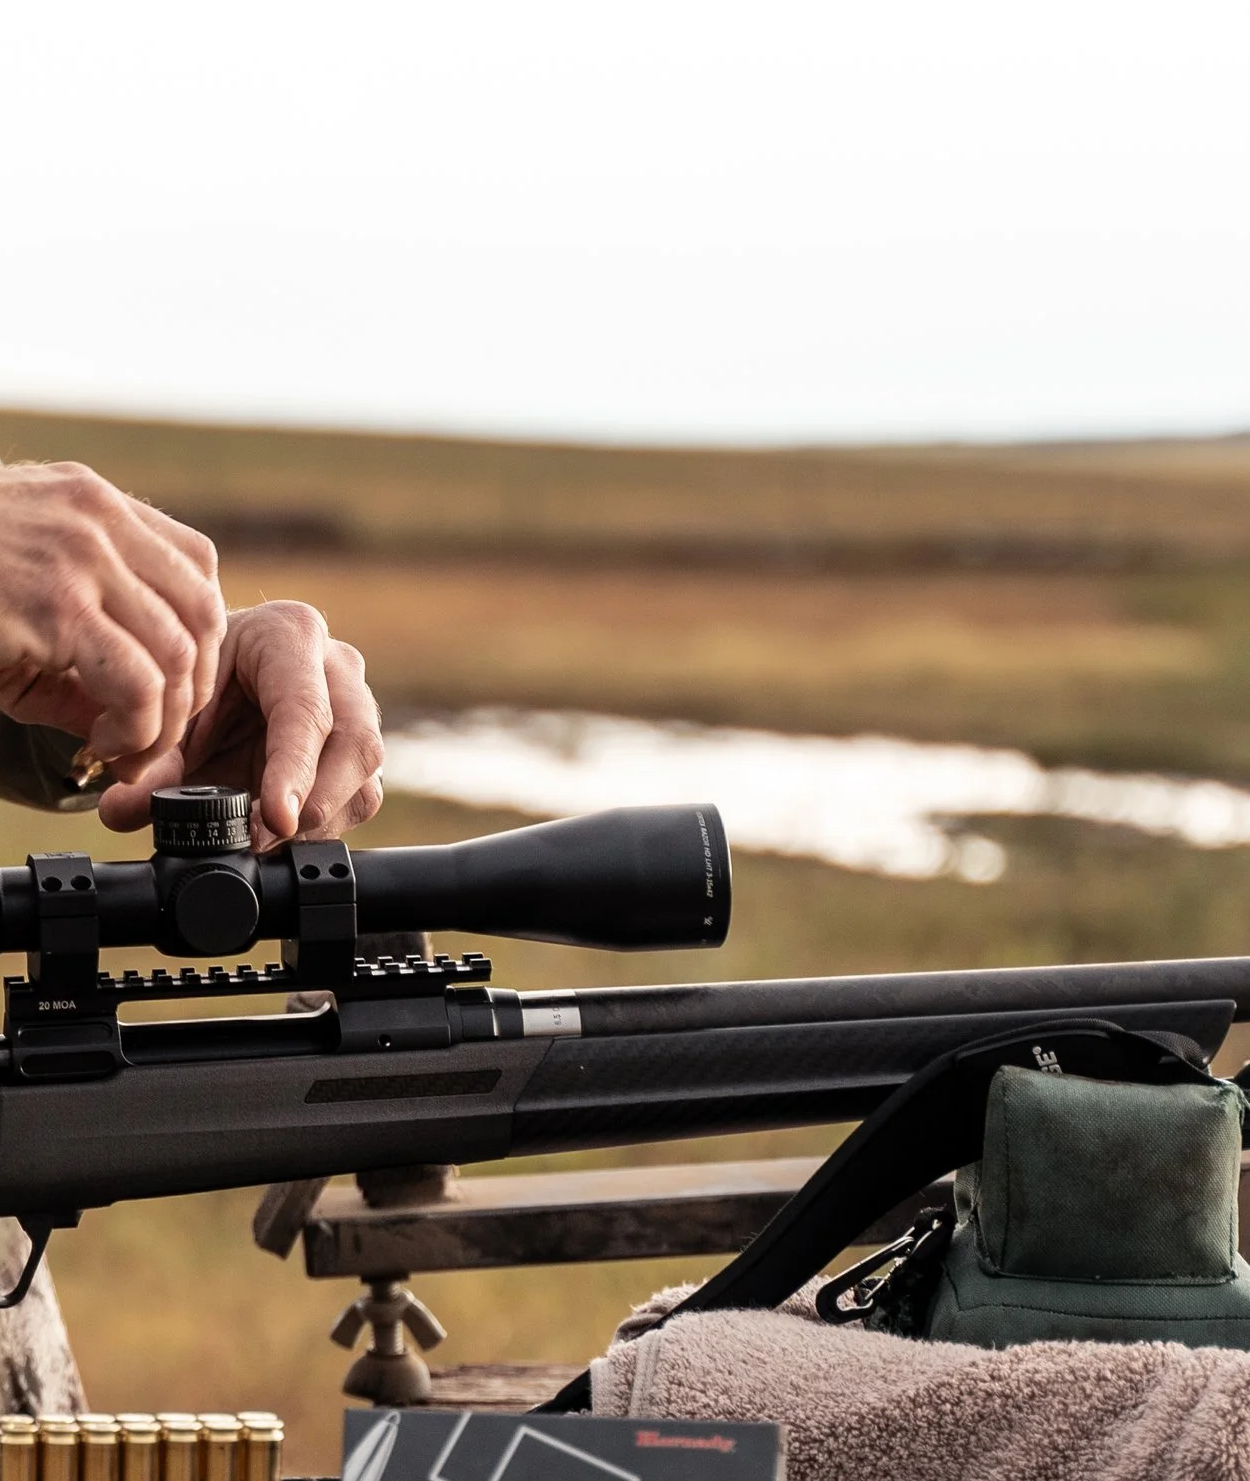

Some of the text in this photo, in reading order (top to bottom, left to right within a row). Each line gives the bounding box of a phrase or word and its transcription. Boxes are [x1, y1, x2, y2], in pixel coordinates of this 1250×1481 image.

[208, 829, 218, 837] 14
[700, 827, 711, 847] RAZOR
[704, 847, 712, 858] HD
[39, 1000, 76, 1010] 20 MOA
